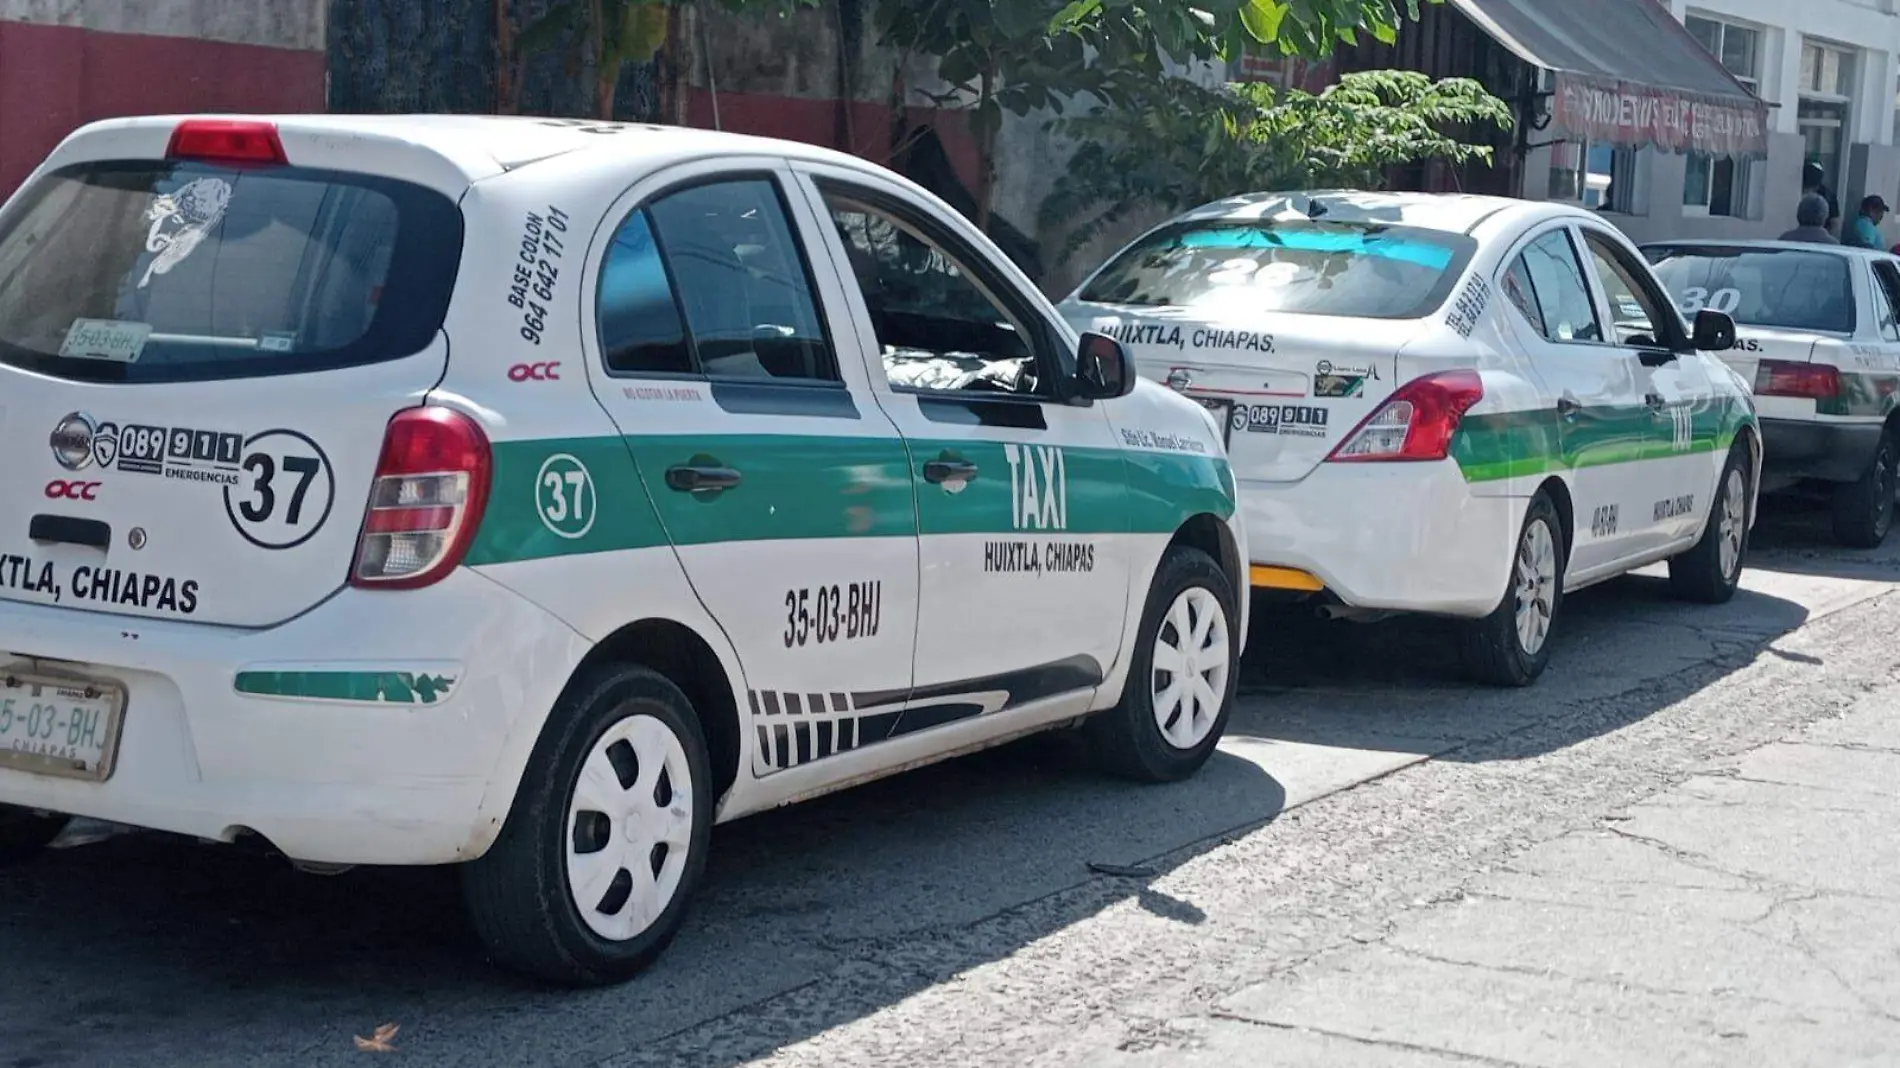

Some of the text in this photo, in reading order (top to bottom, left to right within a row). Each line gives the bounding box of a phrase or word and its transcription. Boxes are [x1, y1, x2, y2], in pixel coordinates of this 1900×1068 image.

[508, 212, 544, 309] BASE COLON
[520, 205, 569, 345] 964 642 17 01
[1679, 286, 1740, 314] 30
[1192, 329, 1275, 353] CHIAPAS.
[507, 361, 562, 383] OCC
[1250, 406, 1279, 425] 089
[121, 426, 167, 461] 089
[44, 479, 102, 501] OCC
[165, 467, 239, 485] EMERGENCIAS
[238, 452, 320, 525] 37
[1004, 443, 1067, 529] TAXI
[544, 470, 584, 522] 37
[984, 541, 1095, 577] HUIXTLA, CHIAPAS
[71, 565, 199, 614] CHIAPAS
[784, 580, 881, 650] 35-03-BHJ
